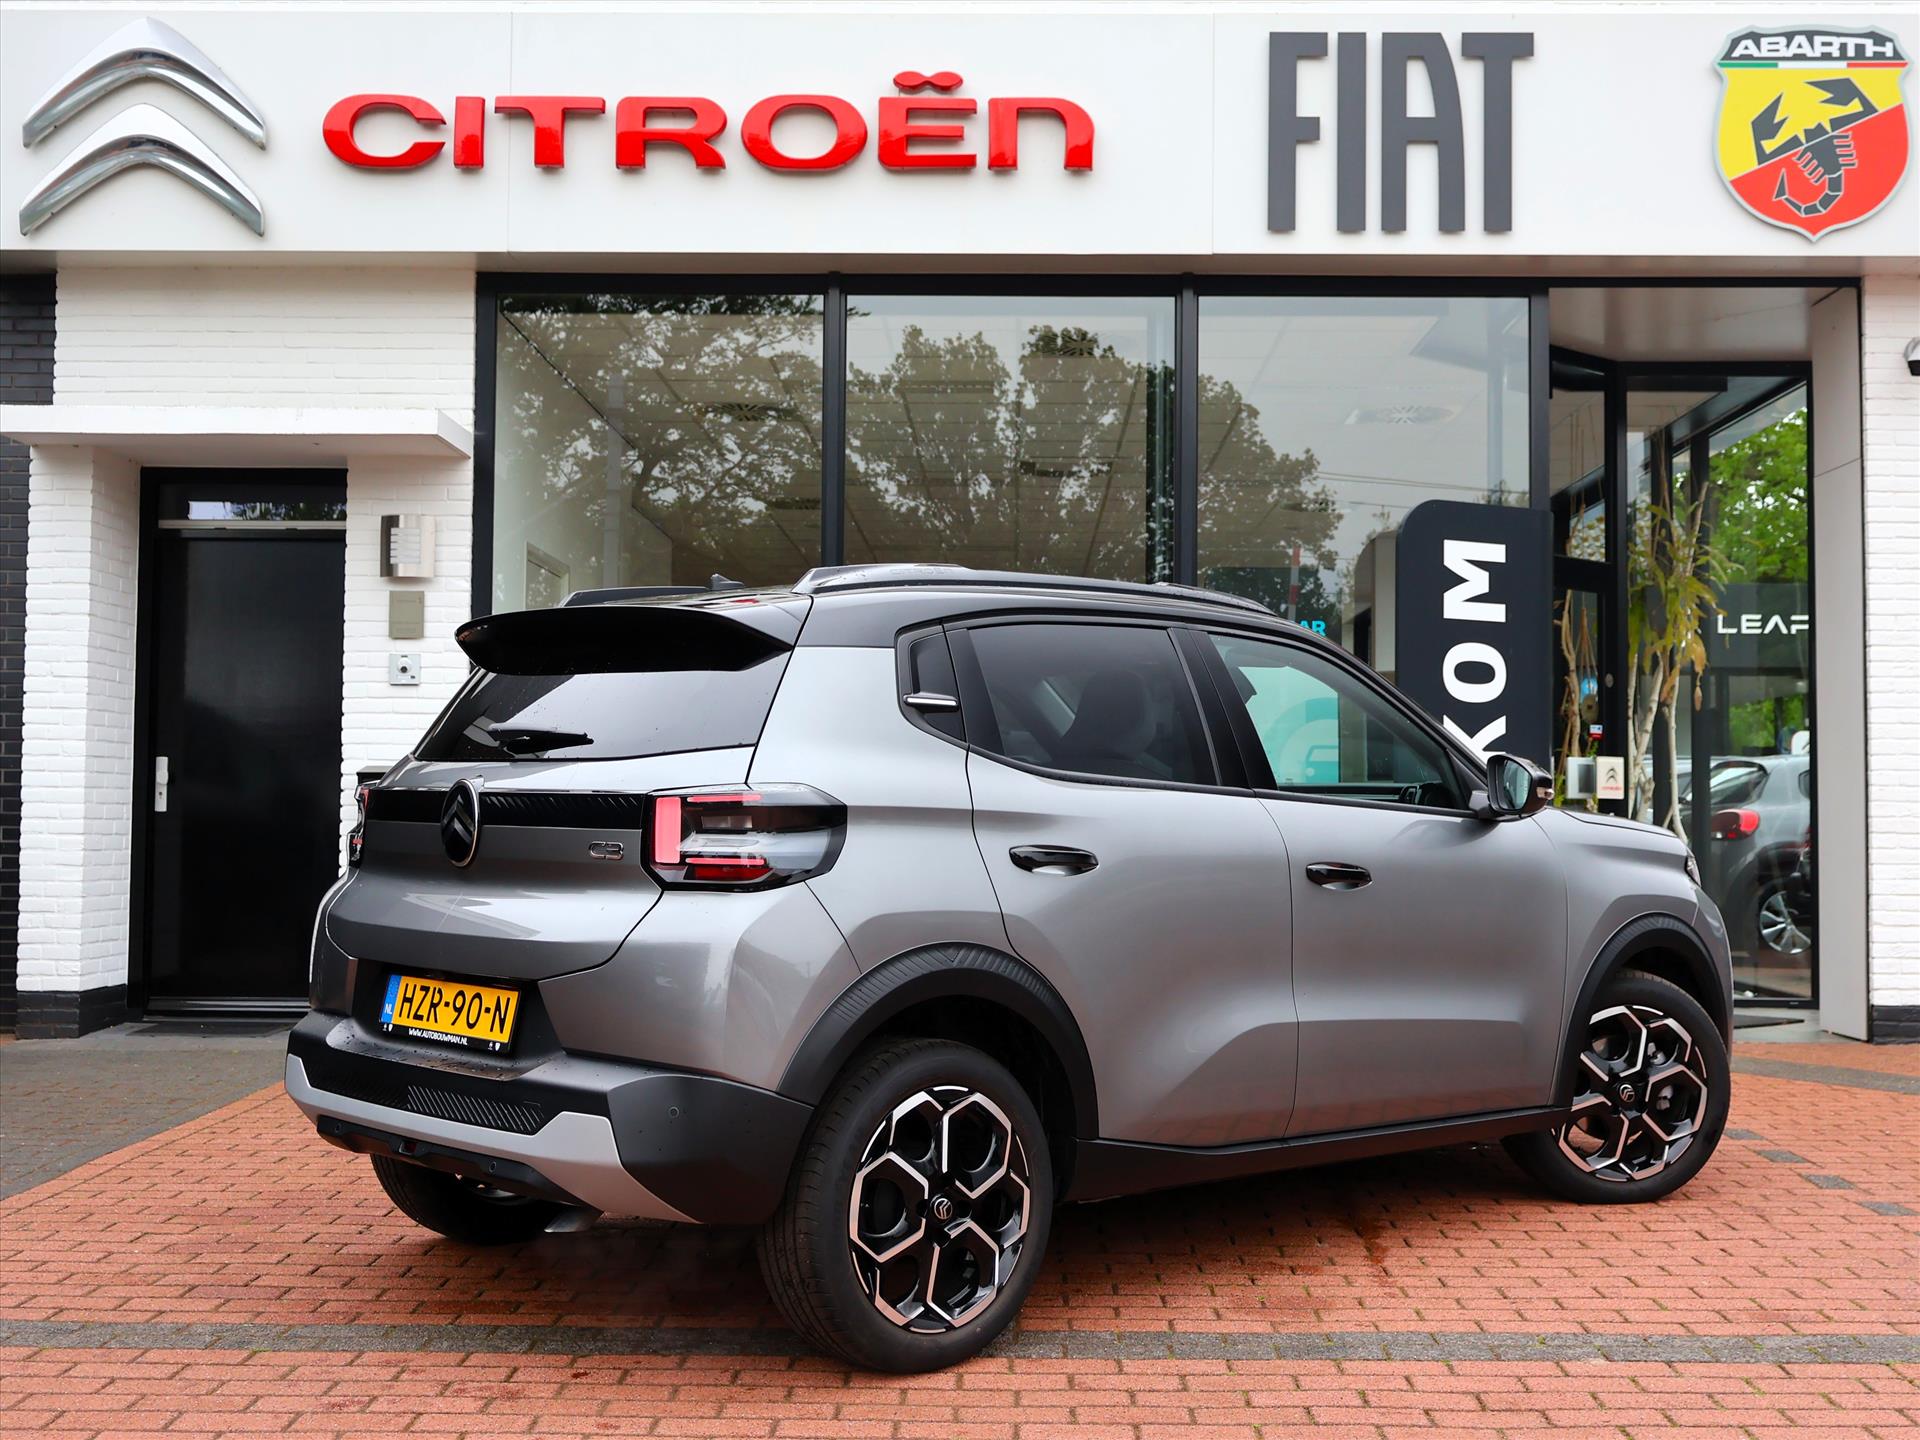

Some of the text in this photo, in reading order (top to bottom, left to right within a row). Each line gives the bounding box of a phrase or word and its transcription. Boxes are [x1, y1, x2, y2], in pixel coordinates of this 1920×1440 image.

[1731, 34, 1894, 58] ABARTH
[322, 71, 1095, 171] CITROËN
[1267, 31, 1534, 233] FIAT
[1443, 539, 1507, 768] KOM
[589, 840, 624, 861] C3
[384, 1003, 393, 1015] NL
[398, 982, 510, 1034] HZR-90-N
